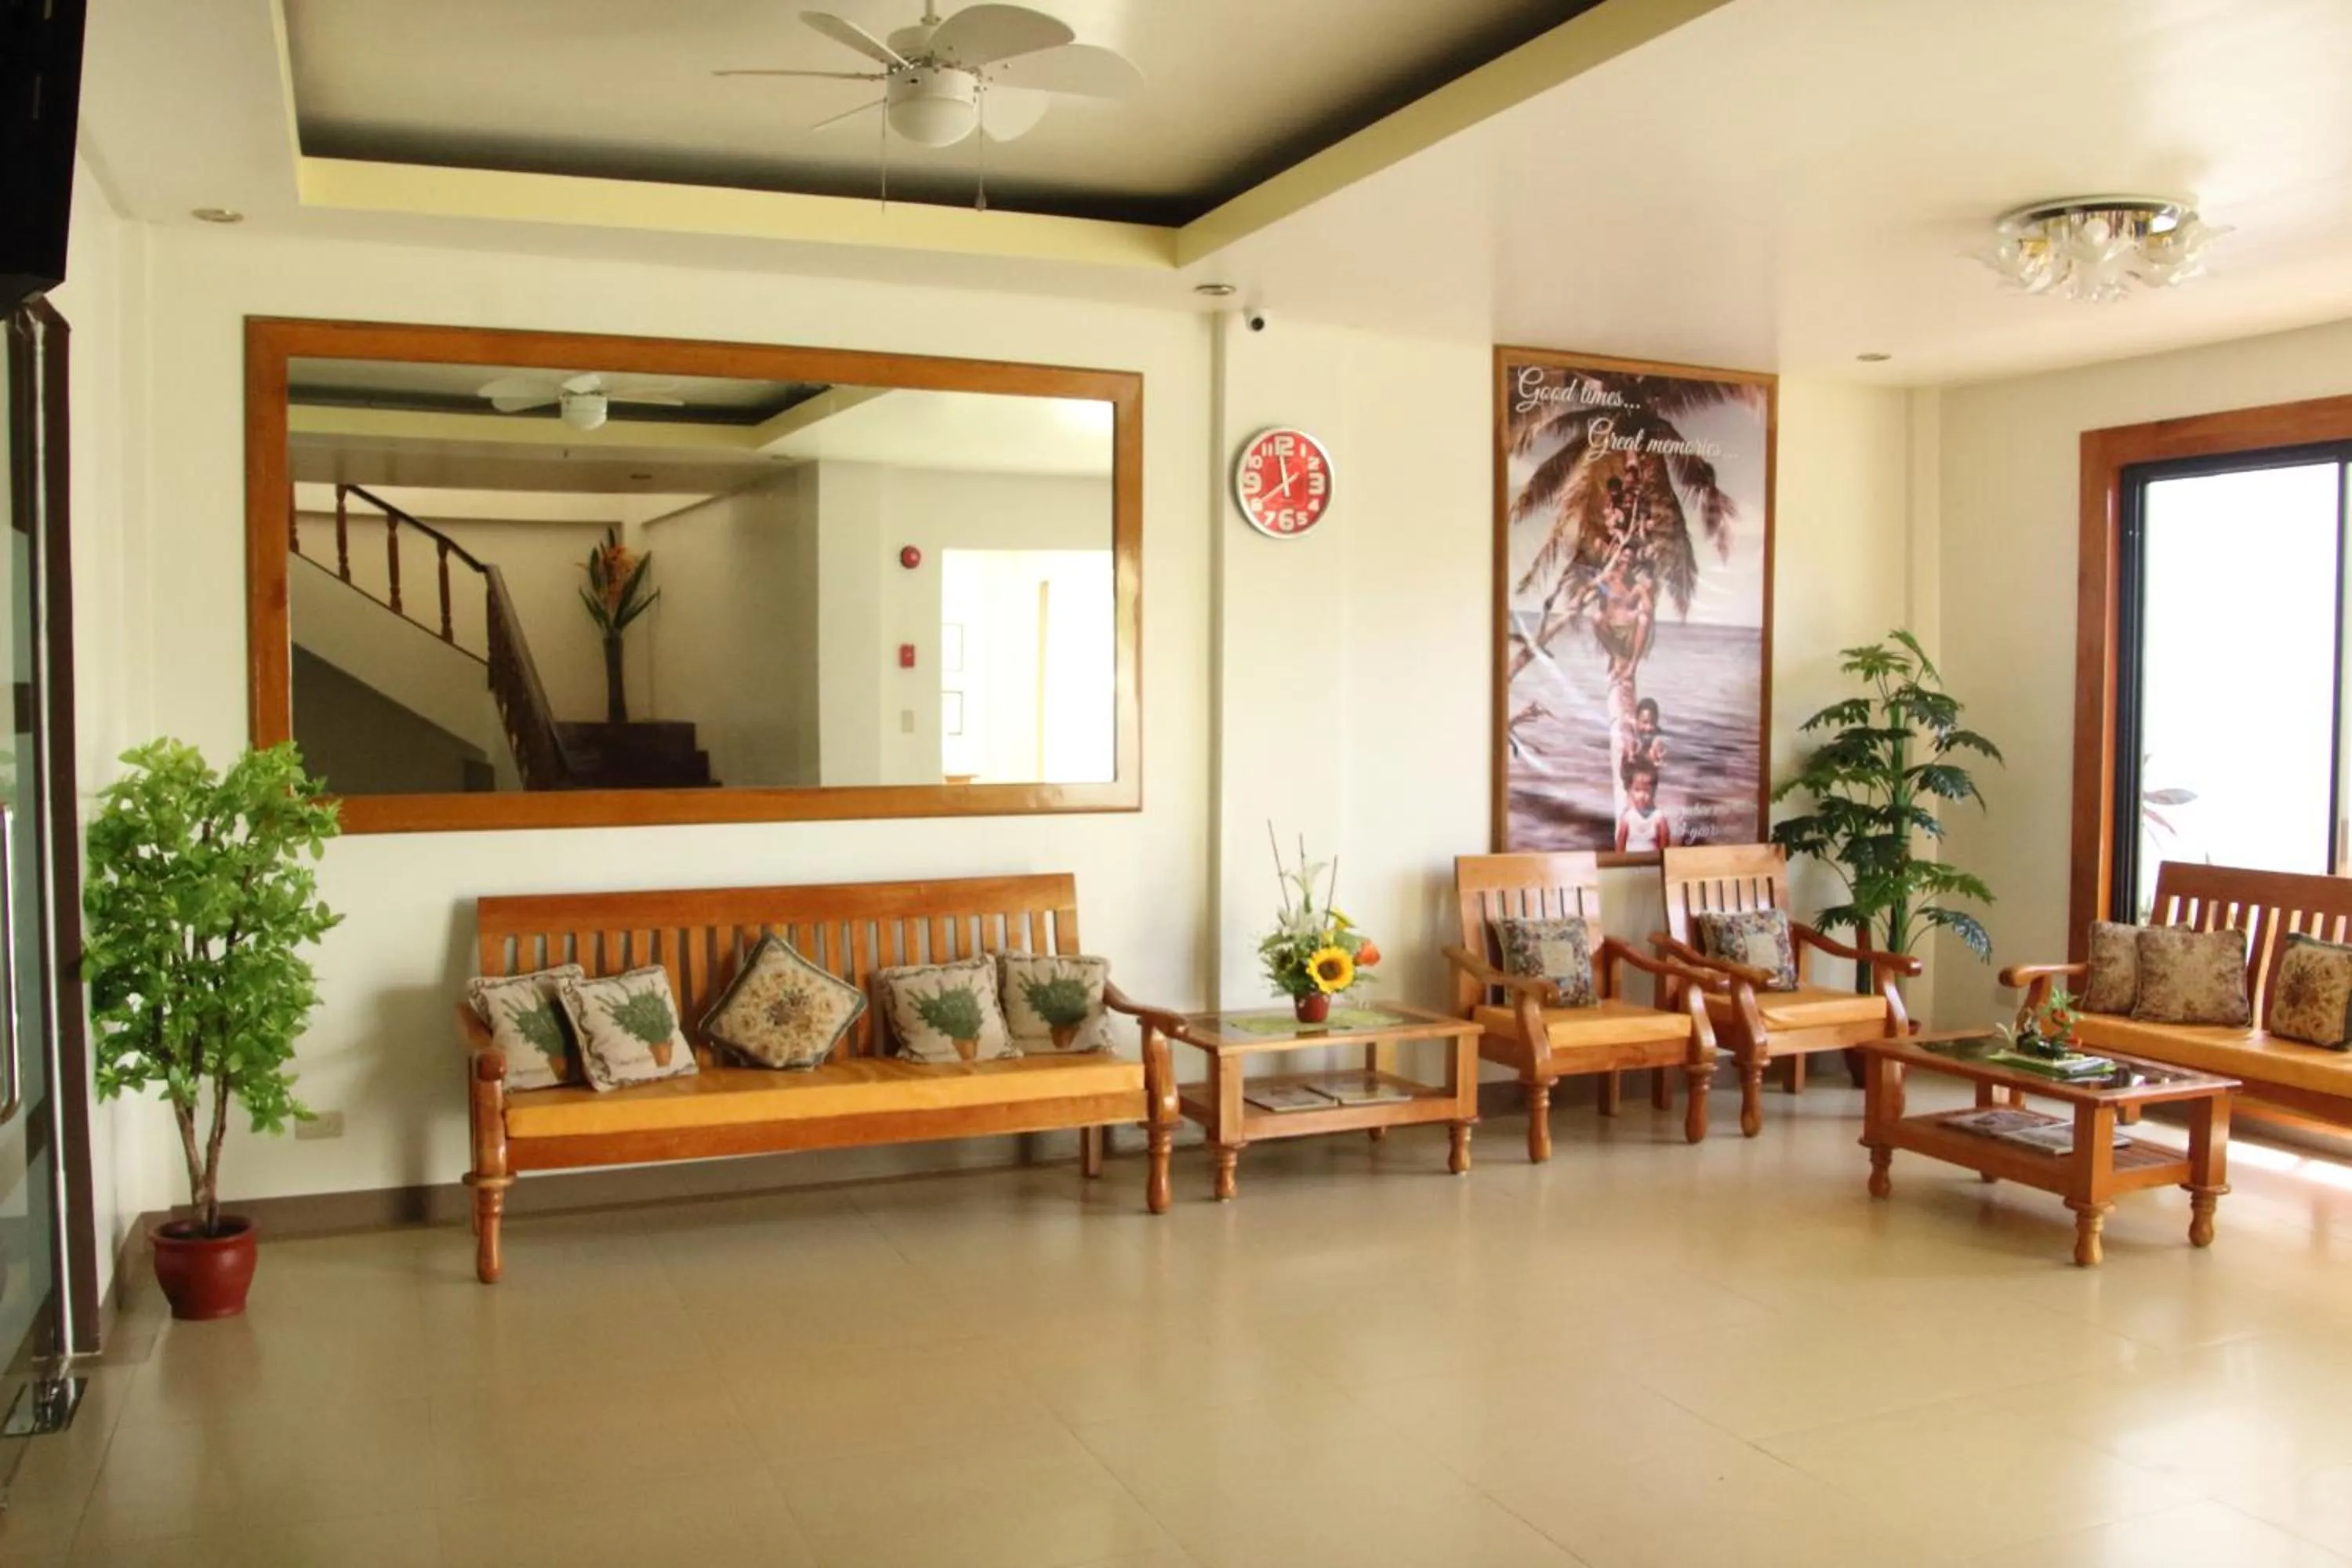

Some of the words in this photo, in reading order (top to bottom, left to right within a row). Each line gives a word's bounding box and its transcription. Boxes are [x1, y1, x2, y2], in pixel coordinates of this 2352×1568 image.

[1515, 366, 1578, 412] Good
[1274, 435, 1294, 456] 12
[1586, 416, 1645, 462] Great
[1308, 456, 1319, 470] 2
[1243, 471, 1263, 495] 9
[1308, 472, 1325, 495] 3
[1264, 511, 1276, 525] 7
[1278, 508, 1295, 531] 6
[1296, 511, 1308, 524] 5
